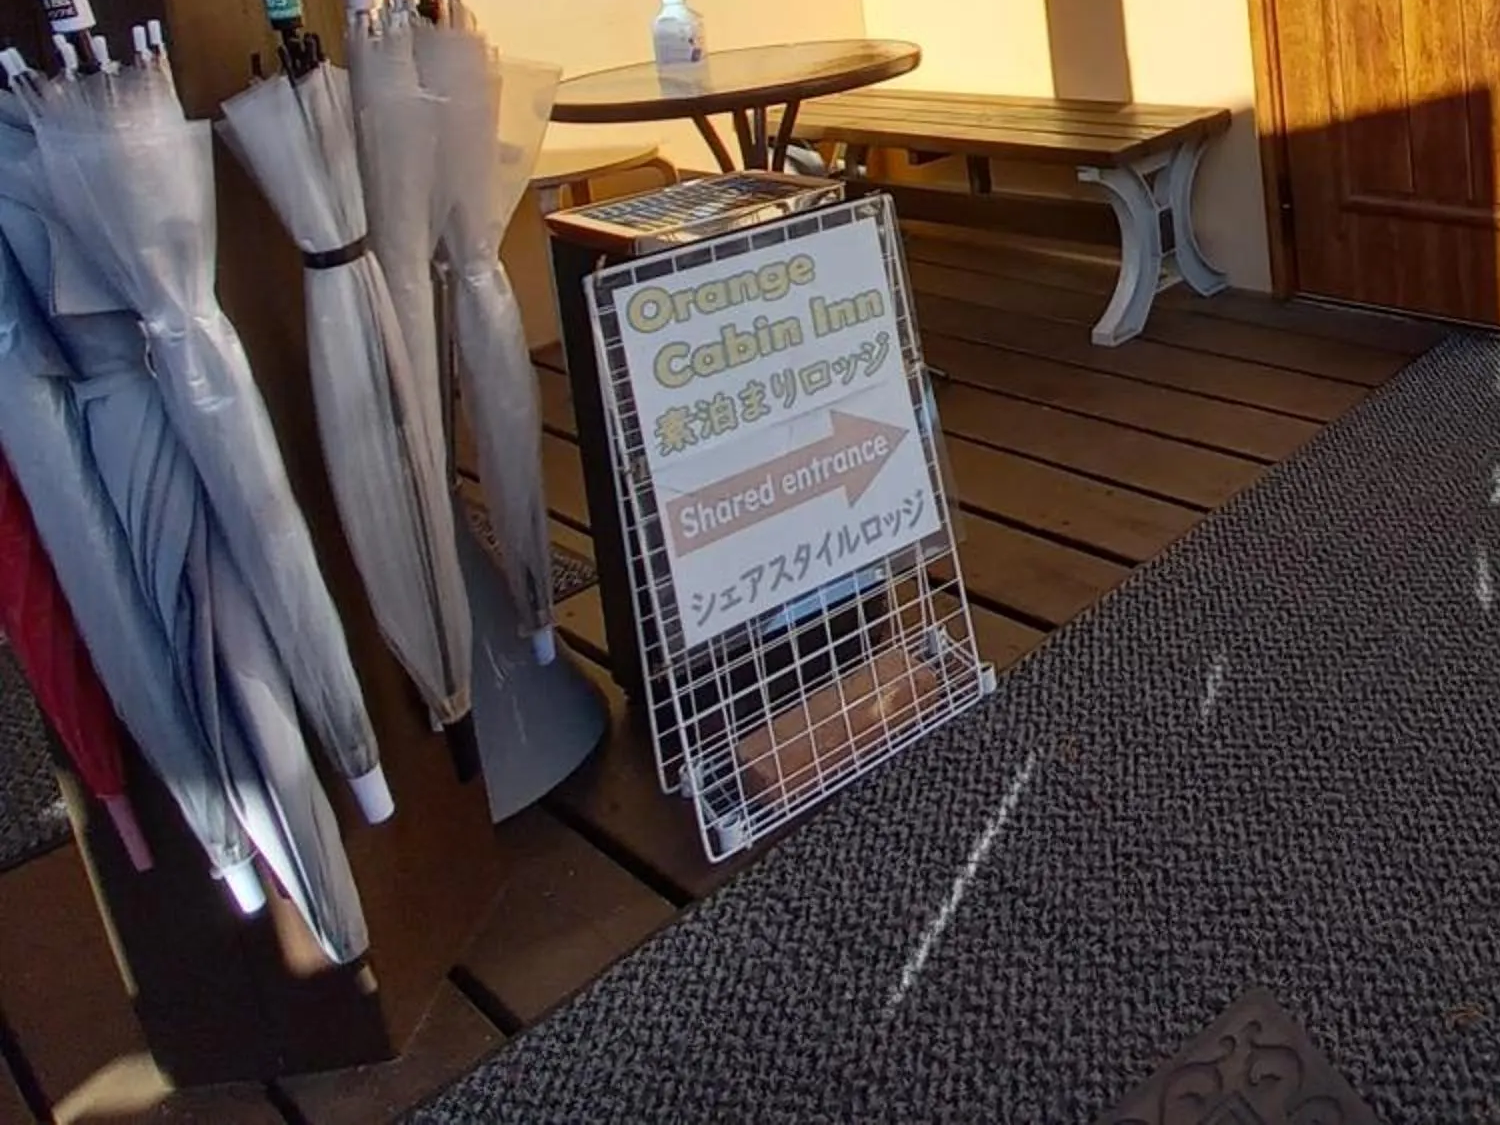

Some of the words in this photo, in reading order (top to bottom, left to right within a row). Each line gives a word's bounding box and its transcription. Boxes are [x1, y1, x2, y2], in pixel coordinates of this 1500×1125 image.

[626, 253, 816, 334] Orange
[654, 315, 803, 389] Cabin
[810, 287, 885, 338] Inn
[654, 331, 890, 457] 素泊まりロッジ
[680, 476, 775, 539] Shared
[782, 433, 890, 496] entrance
[691, 488, 926, 626] シェアスタイルロッジ
